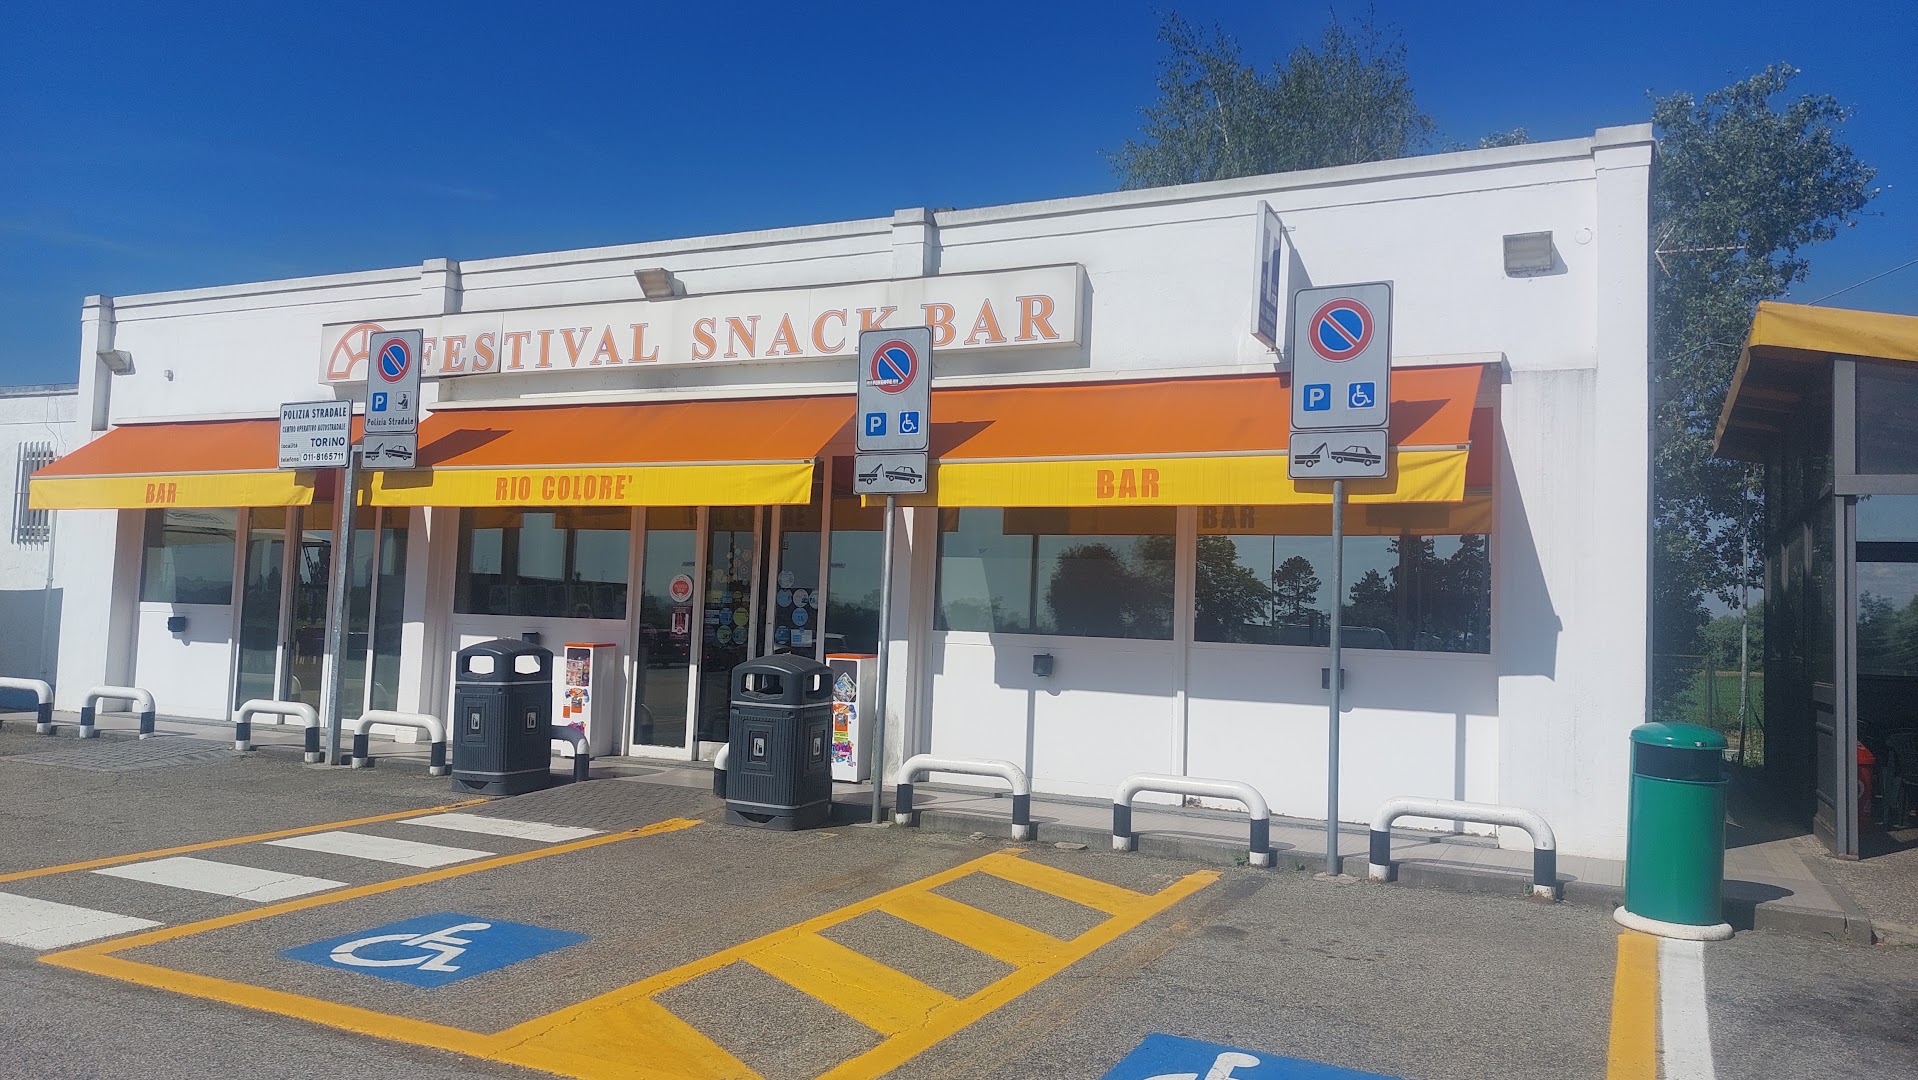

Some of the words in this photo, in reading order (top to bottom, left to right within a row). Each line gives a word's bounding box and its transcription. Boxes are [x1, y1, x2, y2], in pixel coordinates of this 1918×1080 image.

[420, 322, 660, 374] FESTIVAL
[691, 305, 898, 361] SNACK
[920, 294, 1060, 347] BAR
[375, 395, 385, 409] P
[1309, 387, 1325, 408] P
[283, 409, 310, 420] POLIZIA
[311, 406, 347, 419] STRADALE
[282, 425, 296, 433] CENTRO
[297, 424, 317, 433] OPERATIVO
[317, 422, 346, 432] AUTOSTRADALE
[366, 417, 387, 427] Polizia
[388, 416, 414, 426] Stradale
[870, 416, 882, 433] P
[310, 436, 346, 448] TORINO
[302, 452, 344, 461] 011-8165711
[495, 476, 531, 501] RIO
[541, 475, 634, 501] COLORE'
[1096, 468, 1160, 499] BAR
[145, 482, 177, 504] BAR
